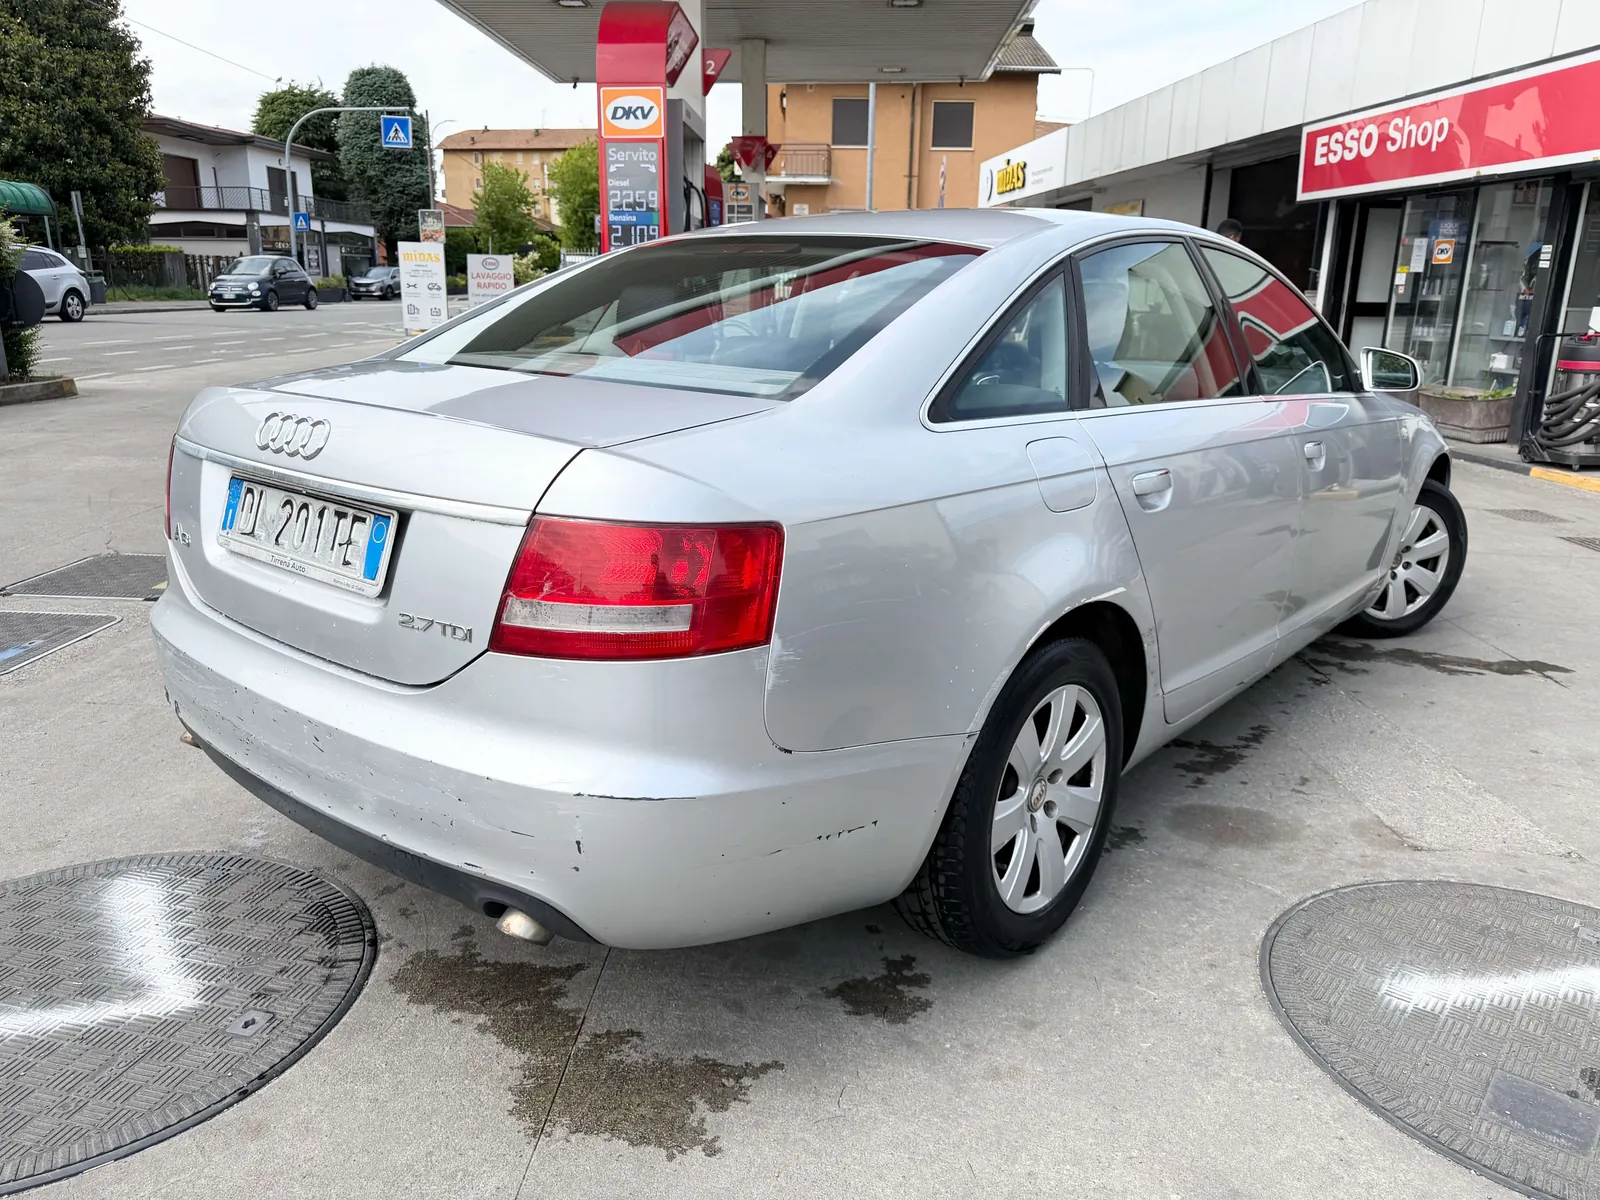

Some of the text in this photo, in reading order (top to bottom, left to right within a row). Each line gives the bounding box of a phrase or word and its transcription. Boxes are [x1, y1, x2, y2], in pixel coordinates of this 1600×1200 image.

[706, 60, 715, 75] 2
[611, 105, 655, 120] DKV
[1314, 115, 1449, 167] ESSO Shop
[608, 147, 657, 161] Servito
[767, 151, 773, 159] 4
[608, 179, 630, 187] Diesel
[609, 213, 636, 222] Benzina
[1436, 247, 1451, 255] DKV
[471, 272, 512, 281] LAVAGGIO
[477, 282, 507, 290] RAPIDO
[270, 554, 306, 573] Tirrena Auto
